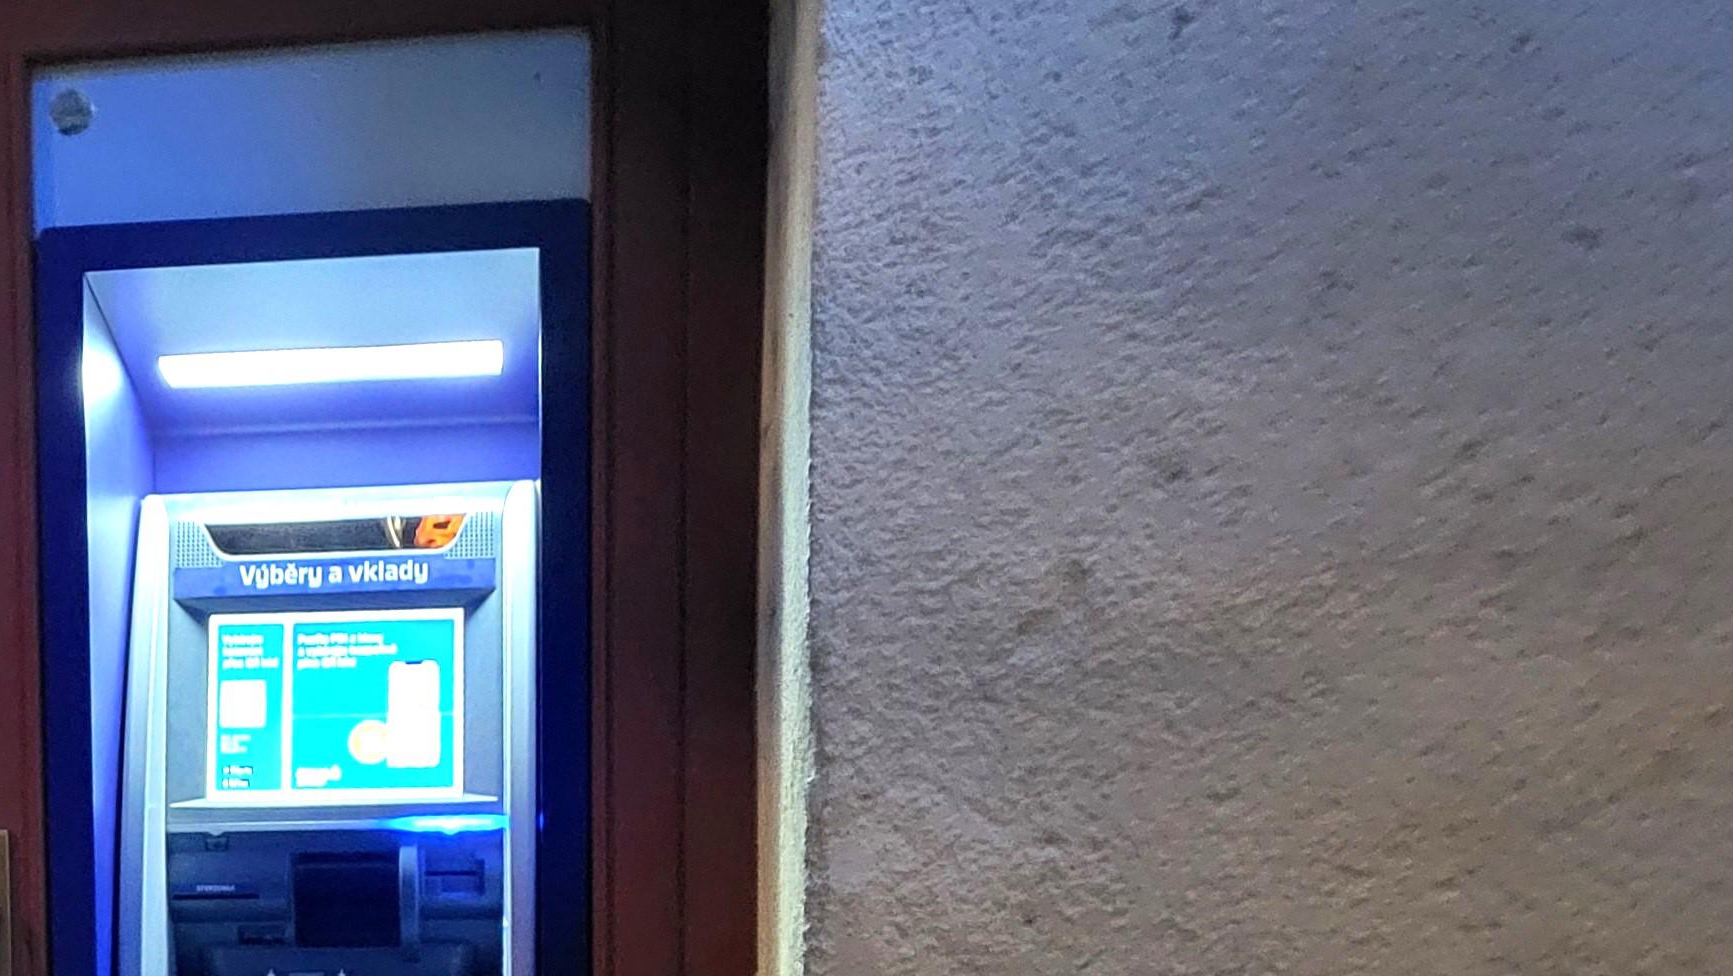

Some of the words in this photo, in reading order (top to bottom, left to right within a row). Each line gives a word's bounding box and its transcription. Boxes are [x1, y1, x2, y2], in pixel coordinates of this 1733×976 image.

[239, 561, 323, 589] Výběry
[328, 564, 343, 583] a
[349, 559, 428, 585] vklady
